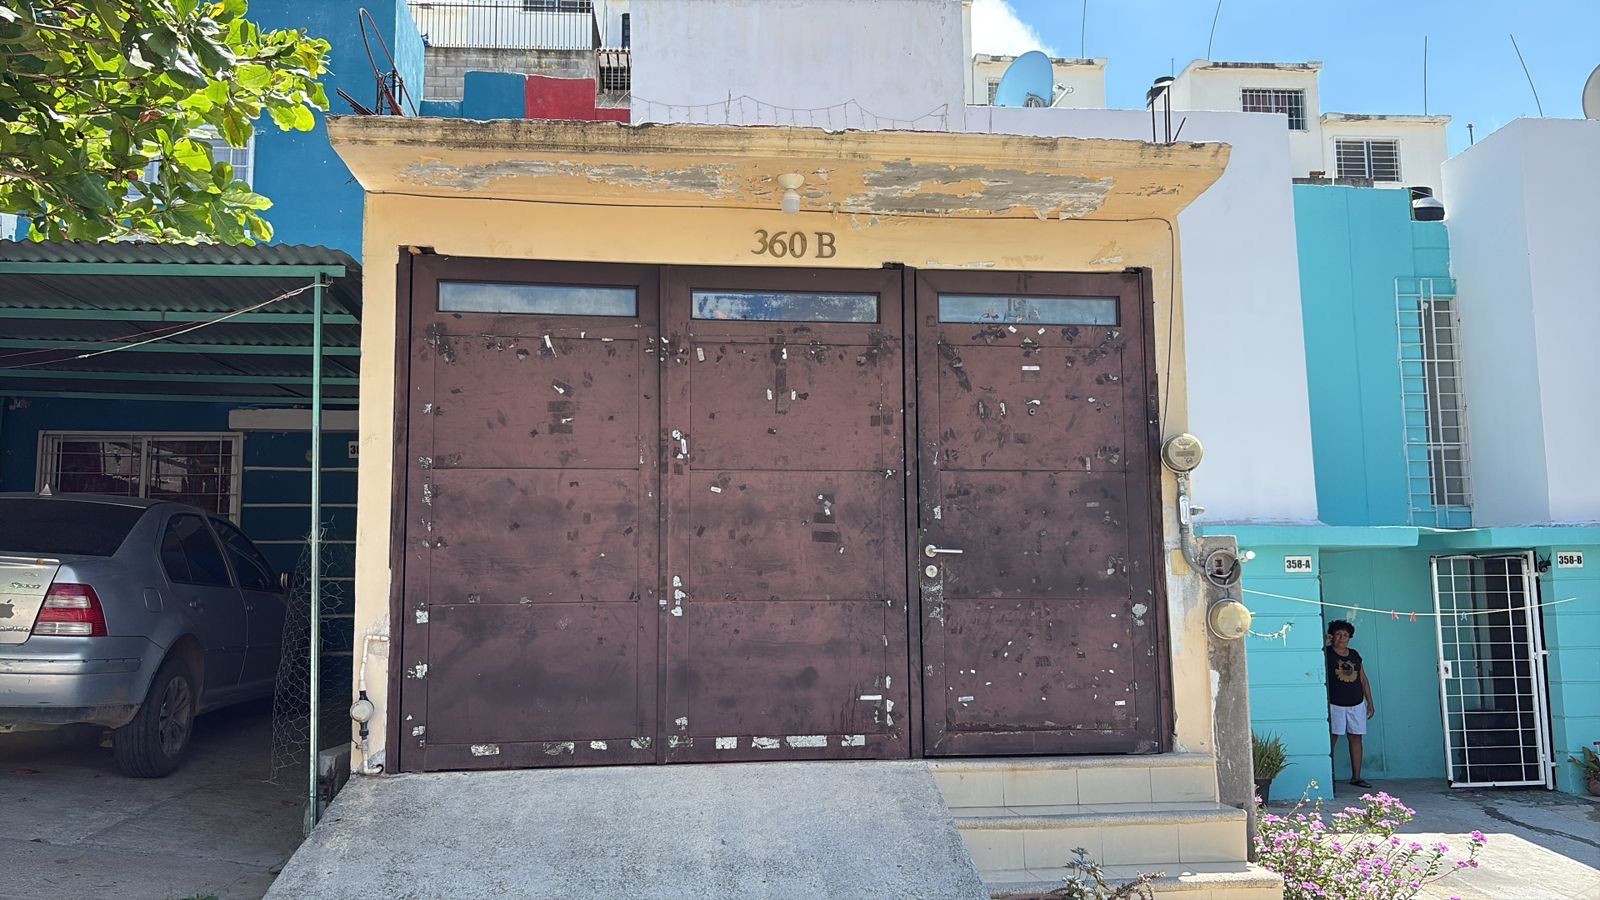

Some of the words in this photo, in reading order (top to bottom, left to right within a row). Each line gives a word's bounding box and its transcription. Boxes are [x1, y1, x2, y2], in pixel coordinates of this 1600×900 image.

[751, 229, 808, 258] 360
[814, 231, 837, 259] B
[1286, 559, 1311, 569] 358-A
[1558, 555, 1582, 565] 358-B
